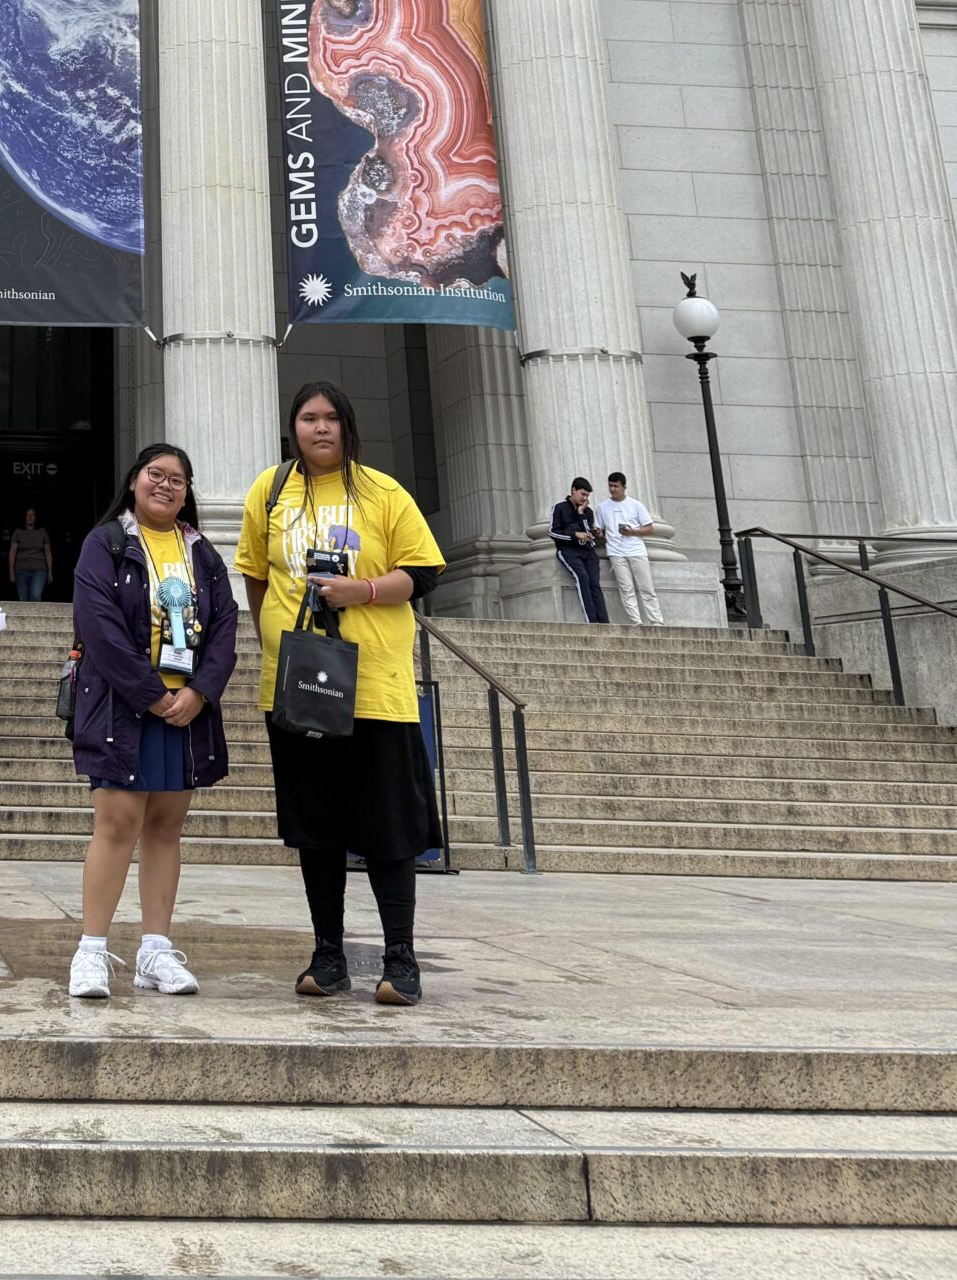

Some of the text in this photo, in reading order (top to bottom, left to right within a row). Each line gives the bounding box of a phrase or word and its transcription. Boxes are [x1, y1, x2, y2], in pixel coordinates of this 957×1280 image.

[284, 73, 314, 142] AND
[287, 151, 319, 248] GEMS
[343, 282, 506, 303] Smithsonian Institution
[13, 462, 44, 475] EXIT
[297, 680, 344, 699] Smithsonian
